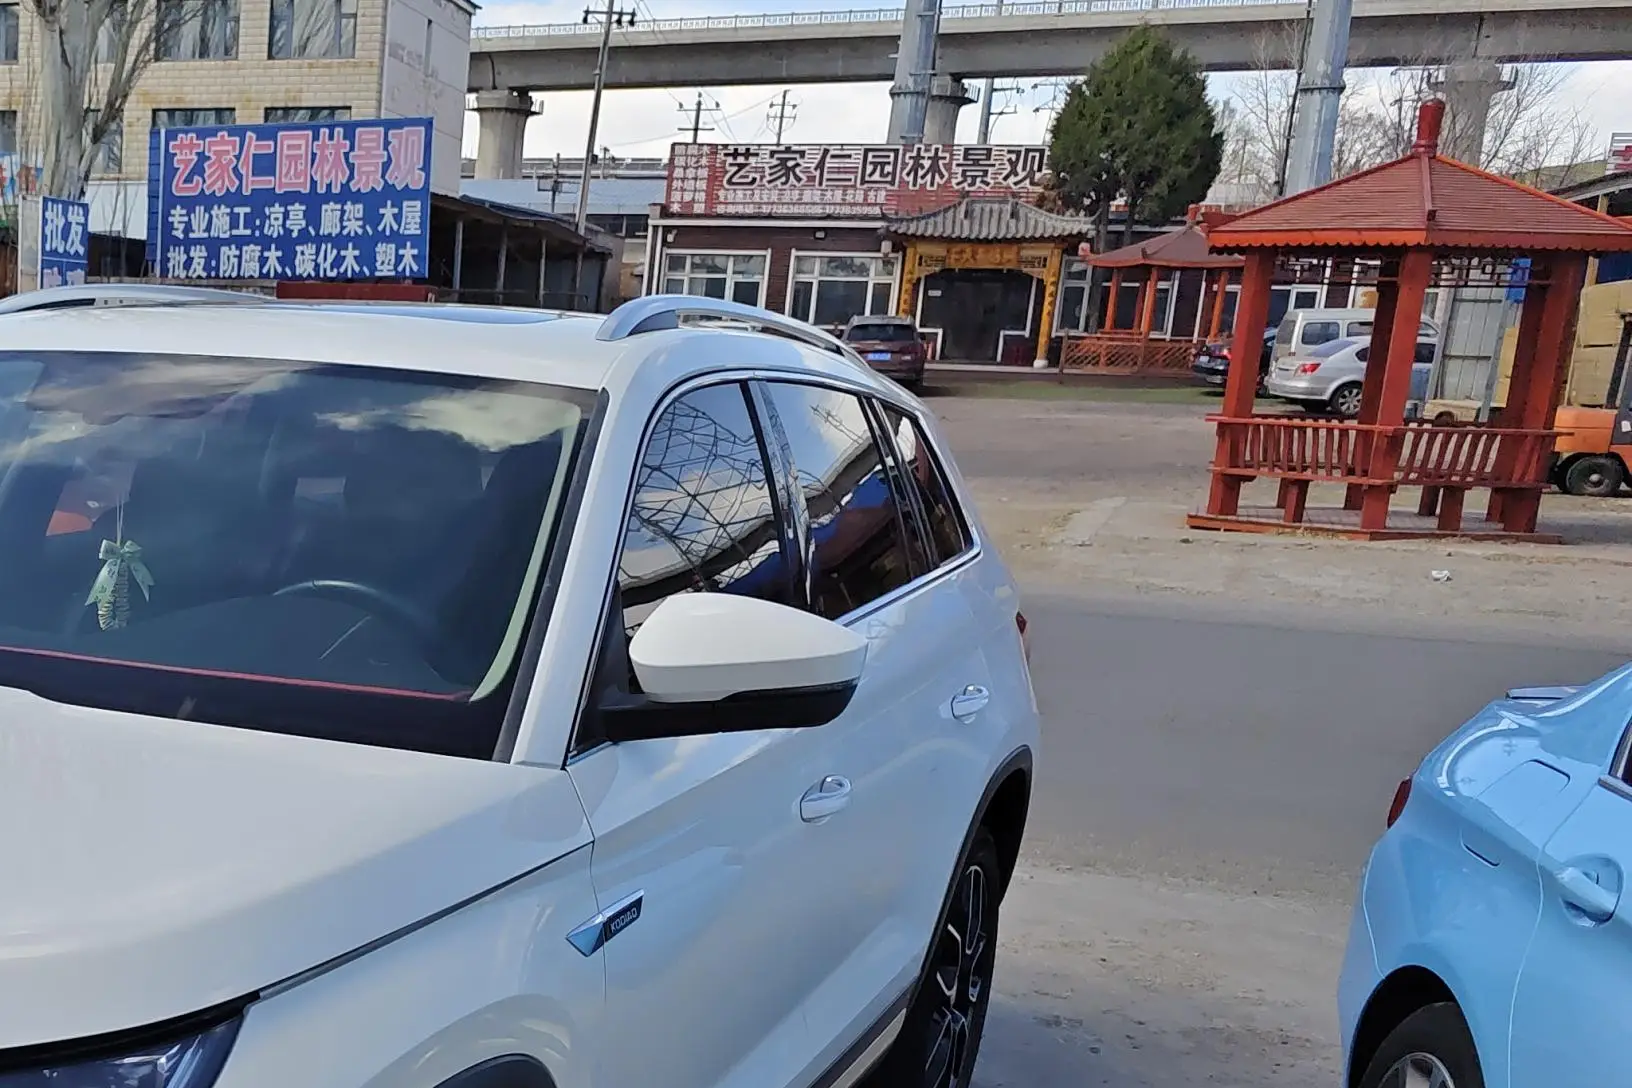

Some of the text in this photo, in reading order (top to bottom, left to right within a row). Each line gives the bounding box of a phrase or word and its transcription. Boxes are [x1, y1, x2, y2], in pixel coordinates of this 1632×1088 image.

[168, 126, 426, 197] 艺家仁园林景观
[723, 144, 1049, 190] 艺家仁园林景观
[44, 200, 85, 256] 批发
[168, 200, 422, 240] 专业施工：凉亭、廊架、木屋
[167, 241, 420, 280] 批发：防腐木、碳化木、塑木
